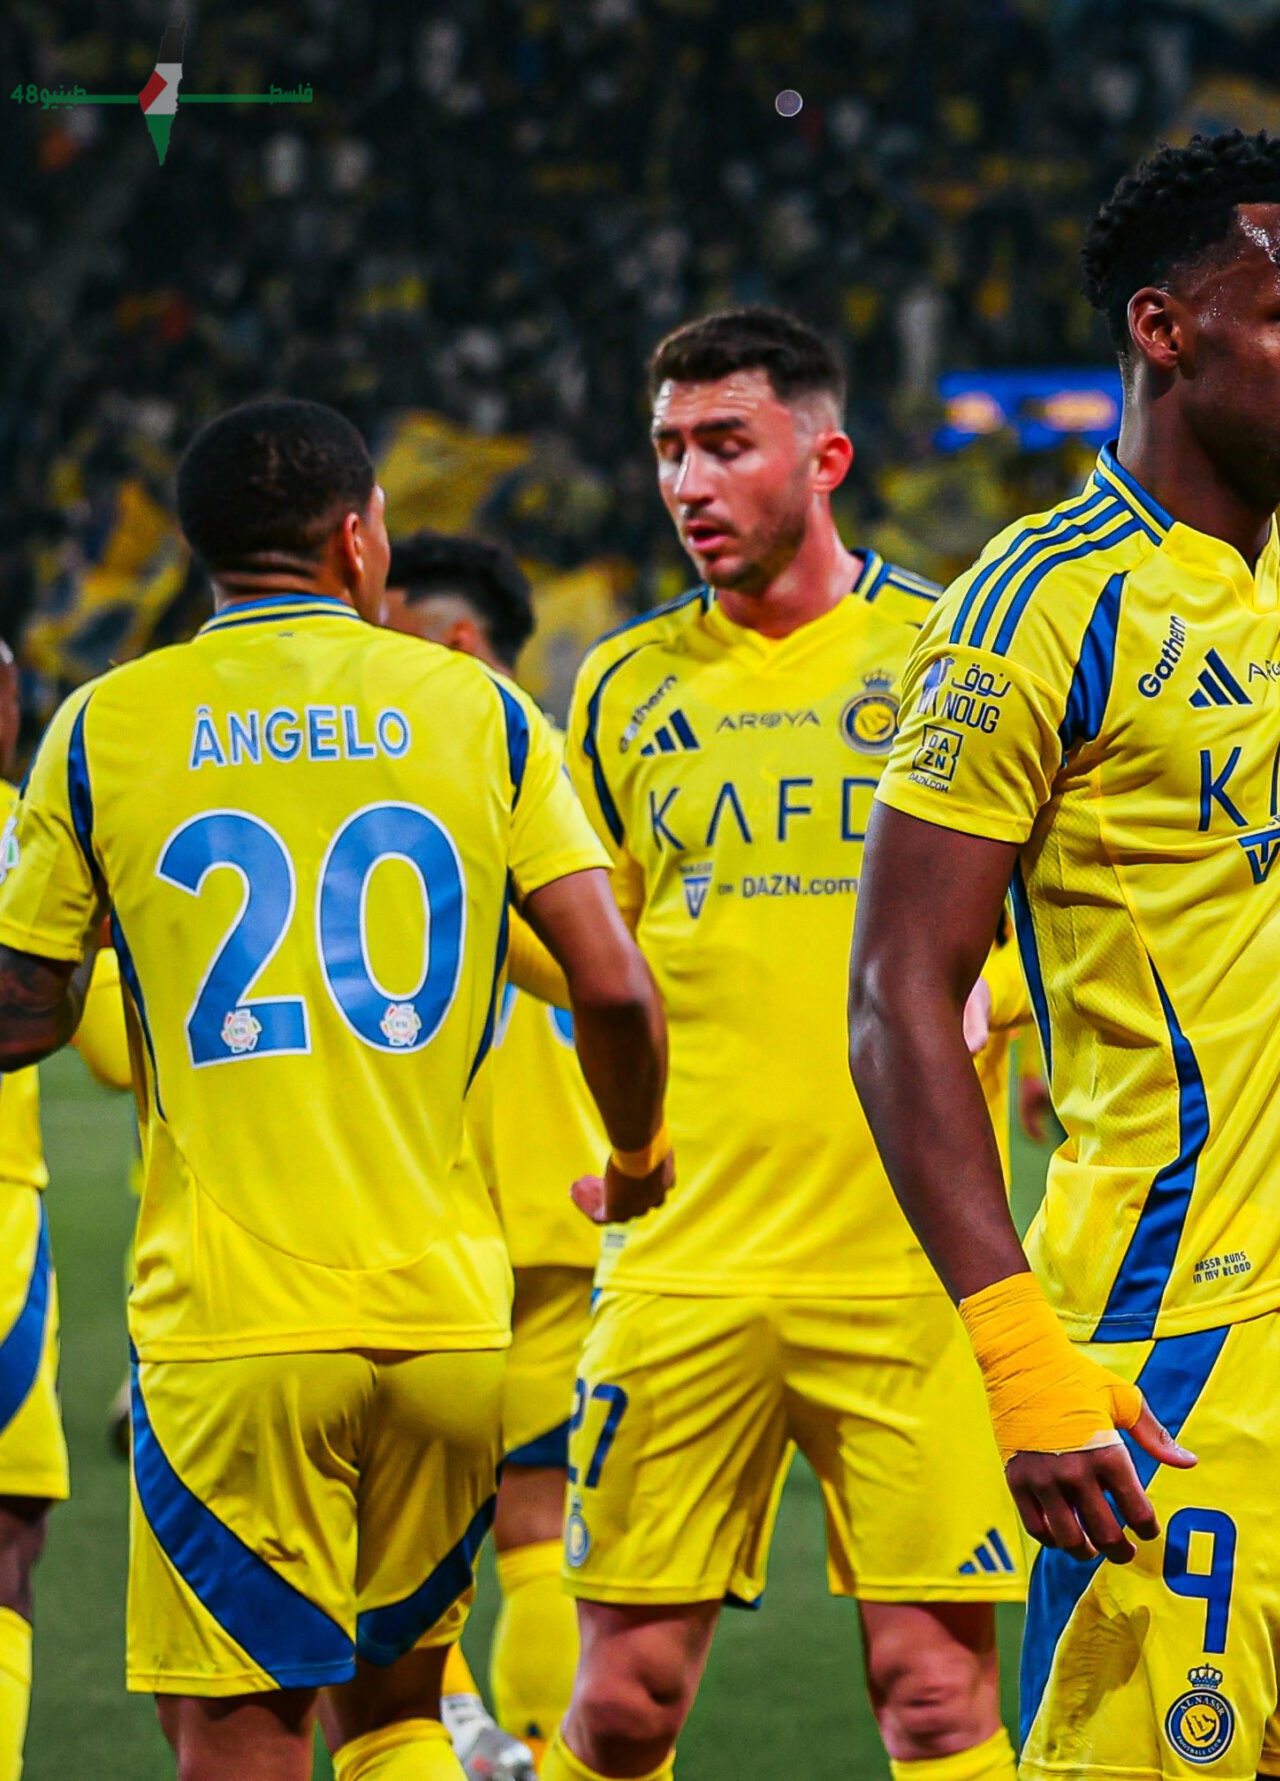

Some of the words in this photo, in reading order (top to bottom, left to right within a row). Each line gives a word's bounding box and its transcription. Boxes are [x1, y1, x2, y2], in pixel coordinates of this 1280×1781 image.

[1138, 615, 1186, 698] Gathern
[951, 663, 1011, 698] نوق
[715, 709, 822, 734] AROYA
[941, 691, 1001, 734] NOUG
[189, 704, 412, 770] ÂNGELO
[908, 773, 950, 794] DAZN.COM
[742, 873, 860, 898] DAZN.com
[156, 801, 468, 1068] 20
[1222, 1261, 1252, 1277] BLOOD
[1163, 1507, 1237, 1655] 9
